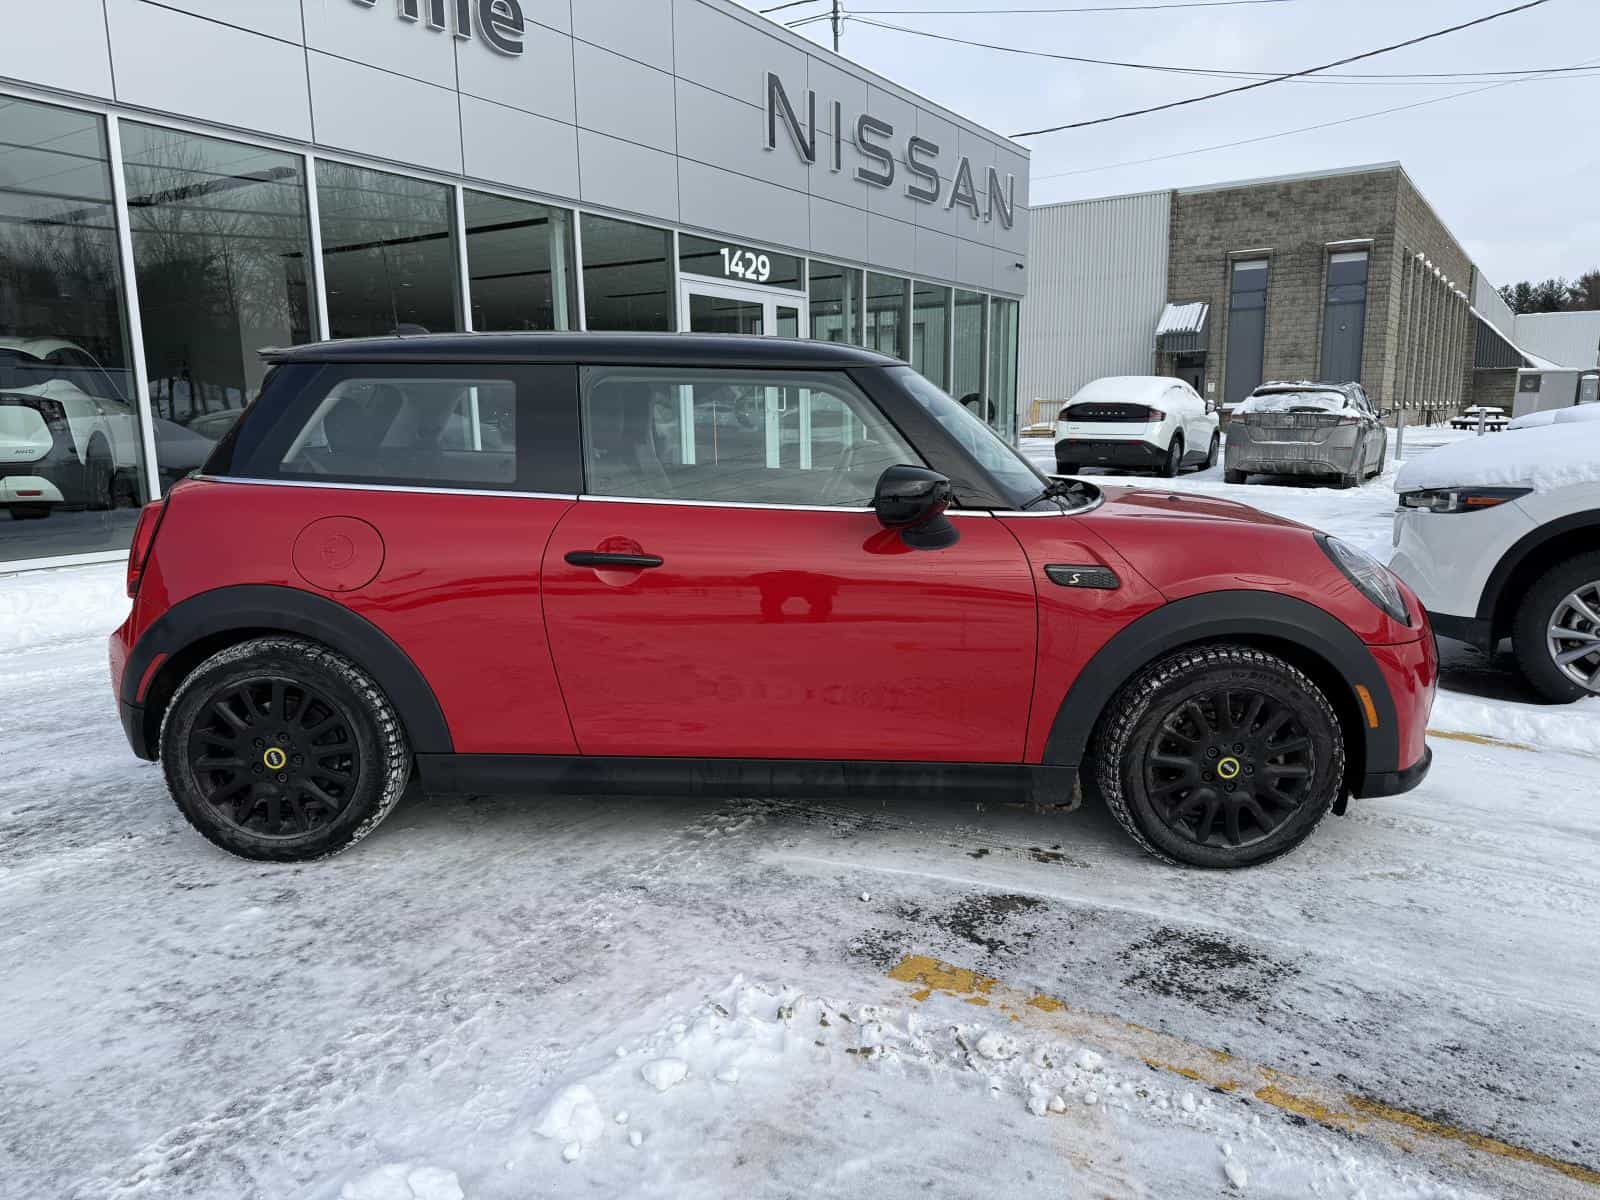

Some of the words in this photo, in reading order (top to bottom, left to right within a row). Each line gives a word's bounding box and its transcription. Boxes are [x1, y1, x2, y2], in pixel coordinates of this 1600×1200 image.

[763, 71, 1015, 229] NISSAN
[720, 247, 771, 282] 1429
[1069, 573, 1081, 584] S
